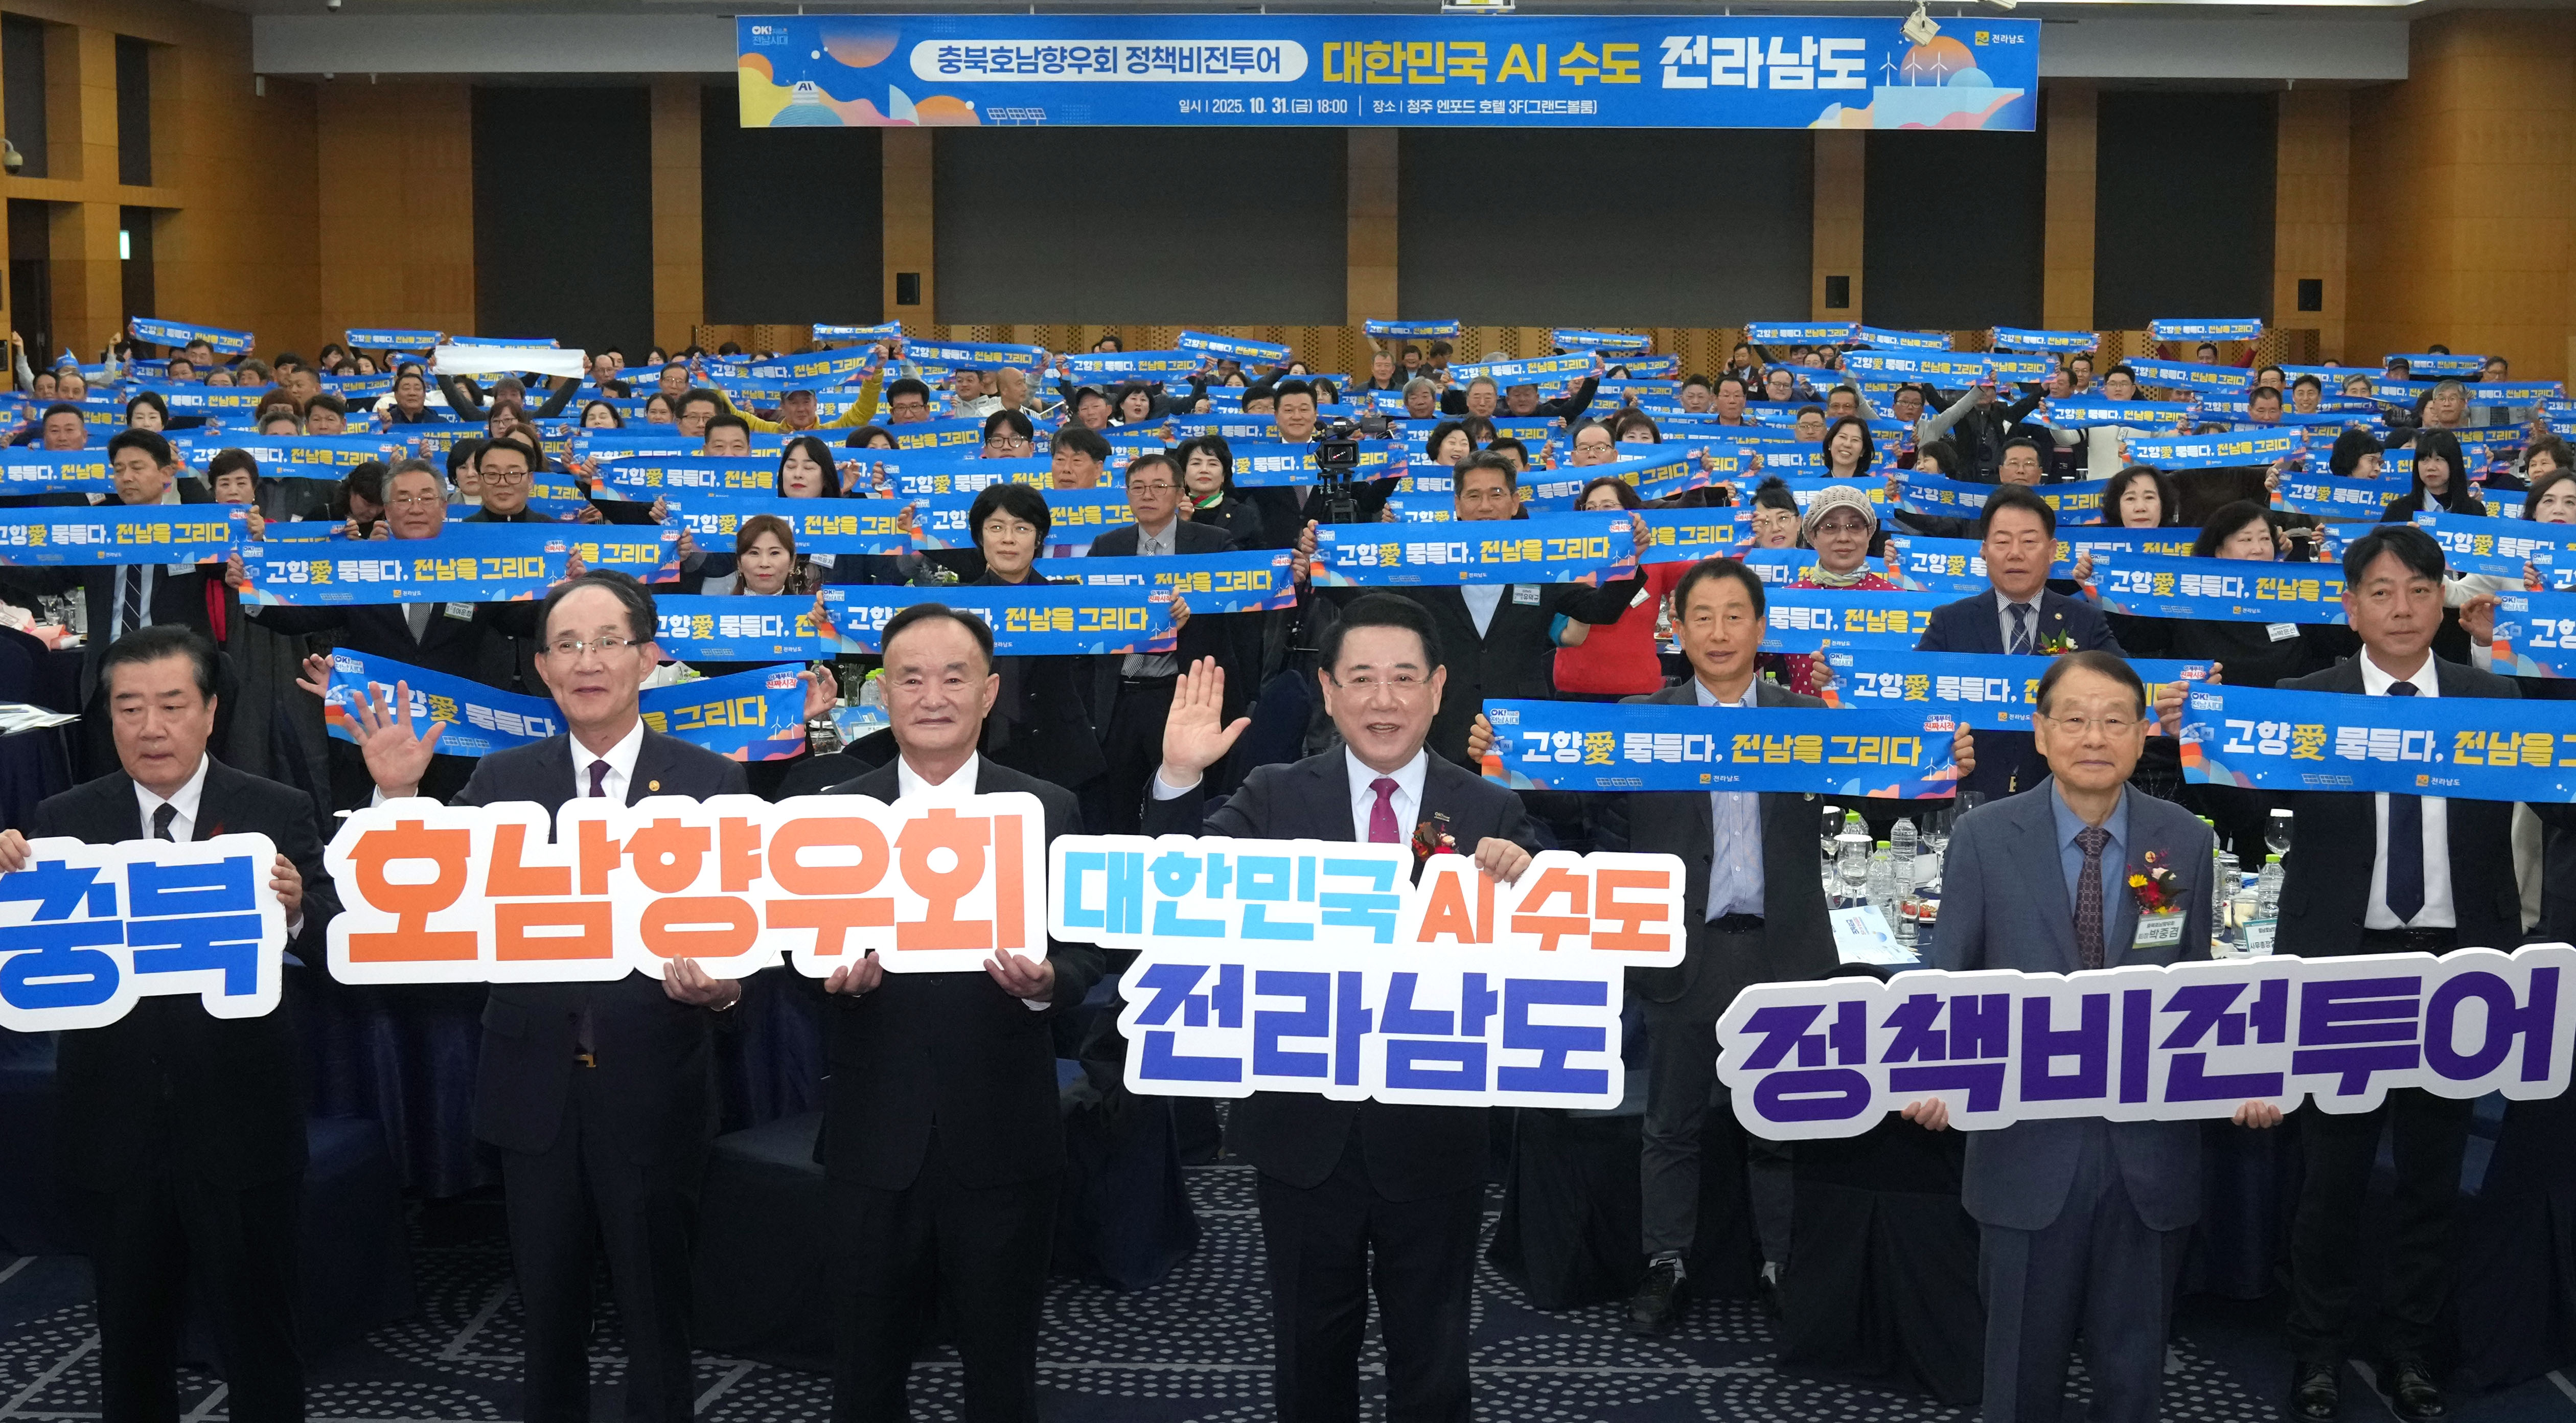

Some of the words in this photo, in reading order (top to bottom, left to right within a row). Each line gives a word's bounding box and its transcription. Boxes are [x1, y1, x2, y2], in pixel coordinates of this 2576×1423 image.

[752, 26, 772, 34] OK!
[1992, 34, 2025, 44] 전라남도
[936, 45, 1119, 75] 충북호남향우회
[1125, 45, 1281, 75] 정책비전투어
[1323, 41, 1488, 84] 대한민국
[1496, 46, 1547, 82] AI
[1558, 41, 1641, 84] 수도
[1659, 35, 1867, 90] 전라남도
[798, 83, 813, 91] AI
[1179, 100, 1201, 112] 일시
[1317, 100, 1347, 113] 18:00
[1373, 100, 1395, 112] 장소
[1407, 99, 1432, 114] 청주
[1437, 100, 1475, 113] 엔포드
[1479, 99, 1505, 114] 호텔
[1509, 99, 1597, 114] 3F(그랜드볼룸)
[2290, 485, 2331, 501] 고향愛
[2334, 488, 2376, 504] 물들다,
[682, 514, 739, 537] 고향愛
[806, 516, 857, 534] 전남을
[1049, 506, 1101, 525] 전남을
[52, 524, 111, 545] 물들다,
[117, 524, 170, 543] 전남을
[175, 523, 230, 543] 그리다
[1680, 525, 1734, 544] 그리다
[2435, 532, 2493, 557] 고향愛
[603, 544, 660, 563] 그리다
[1338, 543, 1400, 567] 고향愛
[1406, 542, 1475, 565] 물들다,
[1481, 539, 1543, 563] 전남을
[1547, 537, 1610, 560] 그리다
[267, 560, 332, 584] 고향愛
[338, 560, 408, 582] 물들다,
[415, 558, 477, 581] 전남을
[482, 557, 545, 579] 그리다
[1912, 554, 1966, 577] 고향愛
[1156, 572, 1211, 594] 전남을
[1215, 571, 1272, 591] 그리다
[2111, 571, 2175, 597] 고향愛
[2180, 575, 2250, 598] 물들다,
[2257, 578, 2319, 601] 전남을
[720, 615, 789, 638] 물들다,
[848, 606, 908, 631] 고향
[1006, 608, 1073, 631] 전남을
[1079, 608, 1148, 631] 그리다
[1769, 607, 1838, 630] 물들다,
[1845, 609, 1908, 632] 전남을
[2530, 618, 2576, 649] 고향
[334, 655, 351, 664] OK!
[1855, 673, 1930, 701] 고향愛
[1936, 676, 2017, 702] 물들다,
[674, 695, 768, 730] 그리다
[1523, 731, 1616, 765] 고향愛
[1624, 733, 1722, 763] 물들다,
[1733, 735, 1823, 763] 전남을
[1829, 736, 1922, 766] 그리다
[2224, 720, 2328, 761] 고향愛
[2335, 727, 2443, 762] 물들다,
[2454, 731, 2554, 766] 전남을
[348, 808, 1024, 961] 호남향우회
[1064, 852, 1400, 943] 대한민국
[1510, 867, 1671, 952] 수도
[1134, 963, 1608, 1094] 전라남도
[1740, 967, 2560, 1122] 정책비전투어
